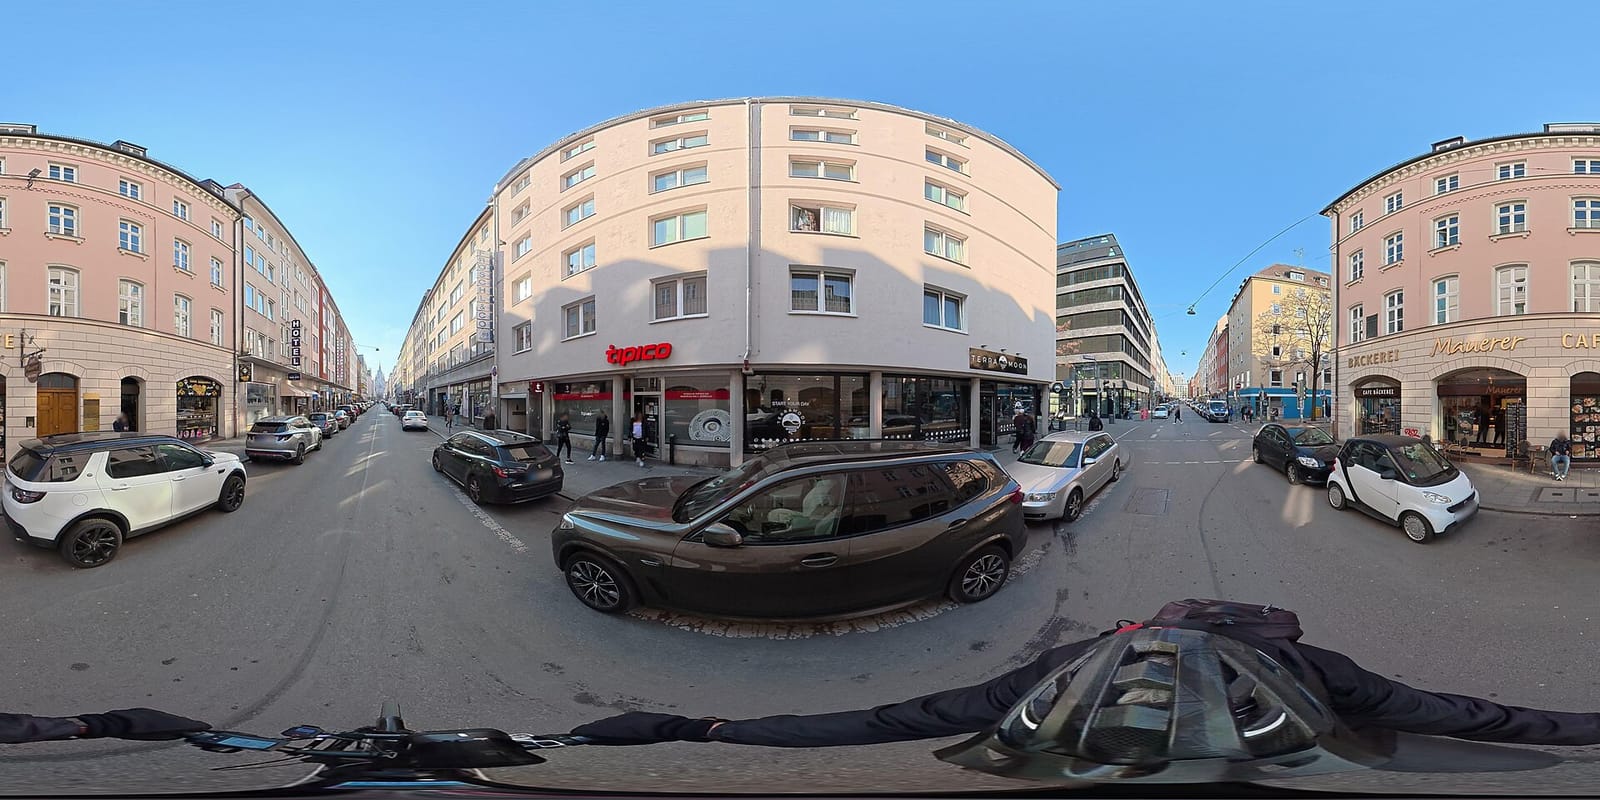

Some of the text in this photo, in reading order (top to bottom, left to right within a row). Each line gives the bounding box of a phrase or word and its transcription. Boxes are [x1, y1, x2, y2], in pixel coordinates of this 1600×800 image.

[292, 320, 300, 365] HOTEL
[1430, 335, 1526, 357] Mauerer
[605, 342, 673, 367] tipico
[970, 354, 1027, 370] TERRA MOON
[1348, 349, 1400, 368] BÄCKEREI
[1486, 385, 1522, 394] Mauerer
